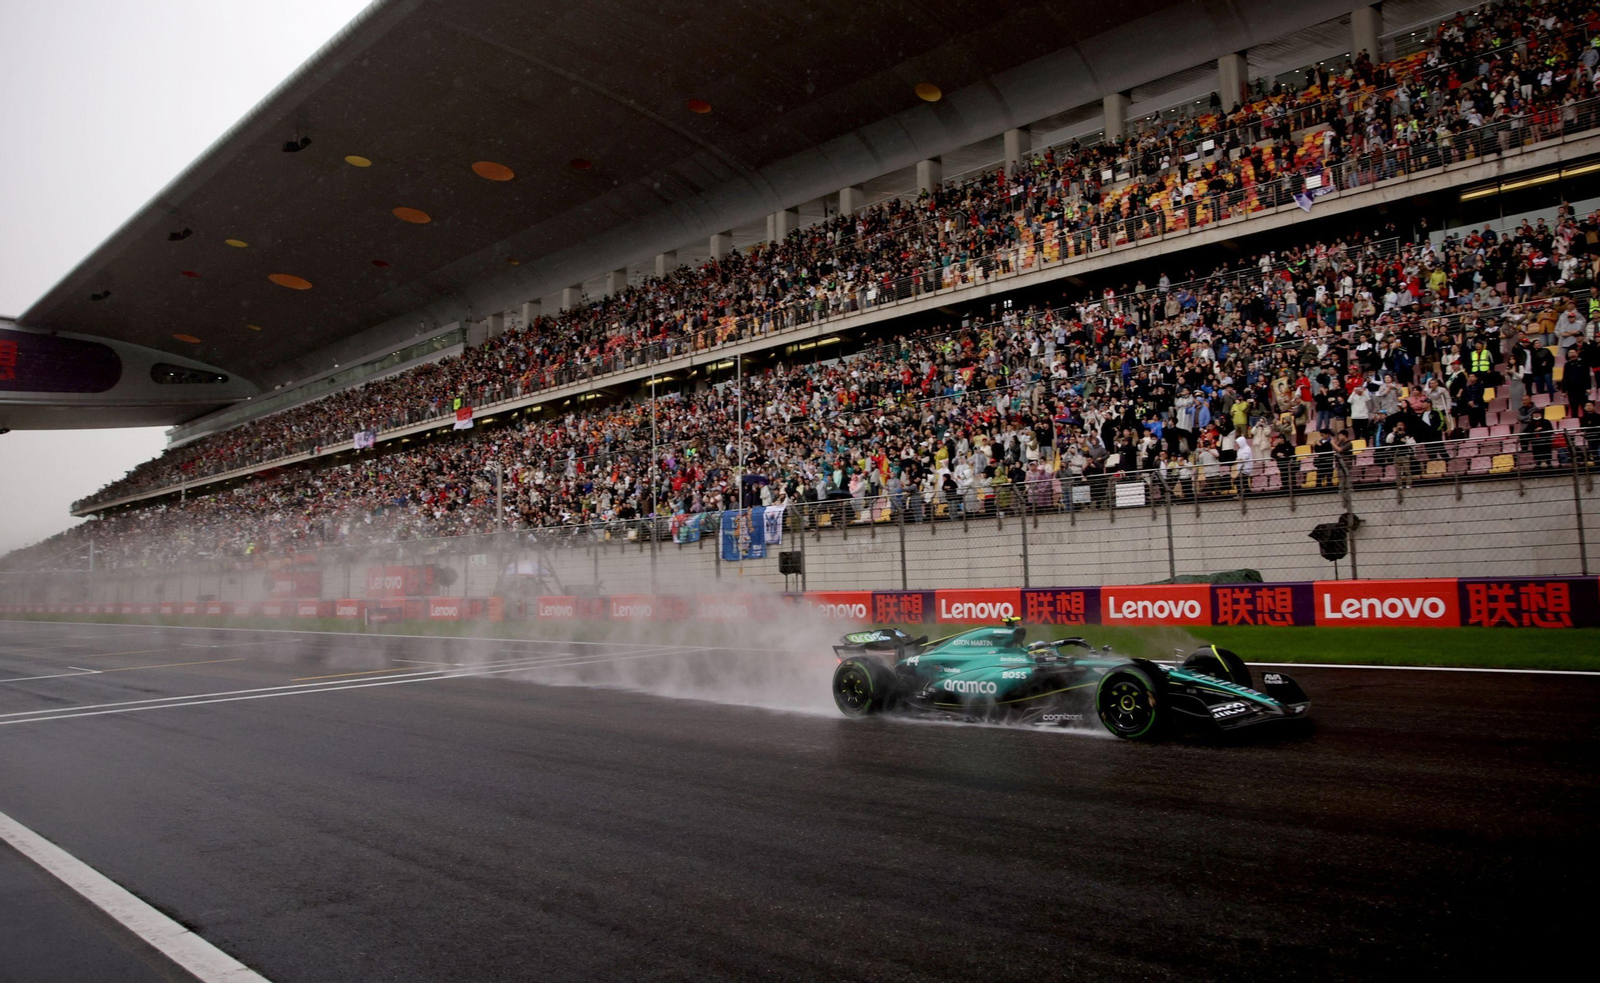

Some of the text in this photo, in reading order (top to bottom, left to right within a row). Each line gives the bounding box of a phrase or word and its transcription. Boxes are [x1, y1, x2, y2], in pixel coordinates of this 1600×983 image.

[875, 594, 923, 624] 联想
[940, 598, 1014, 619] Lenovo
[1025, 591, 1086, 625] 联想
[1108, 596, 1201, 619] Lenovo
[1216, 587, 1294, 626] 联想
[1323, 593, 1446, 619] Lenovo
[1466, 582, 1573, 628] 联想
[943, 679, 997, 695] aramco
[1002, 671, 1027, 680] BOSS
[1042, 712, 1084, 723] cognizant
